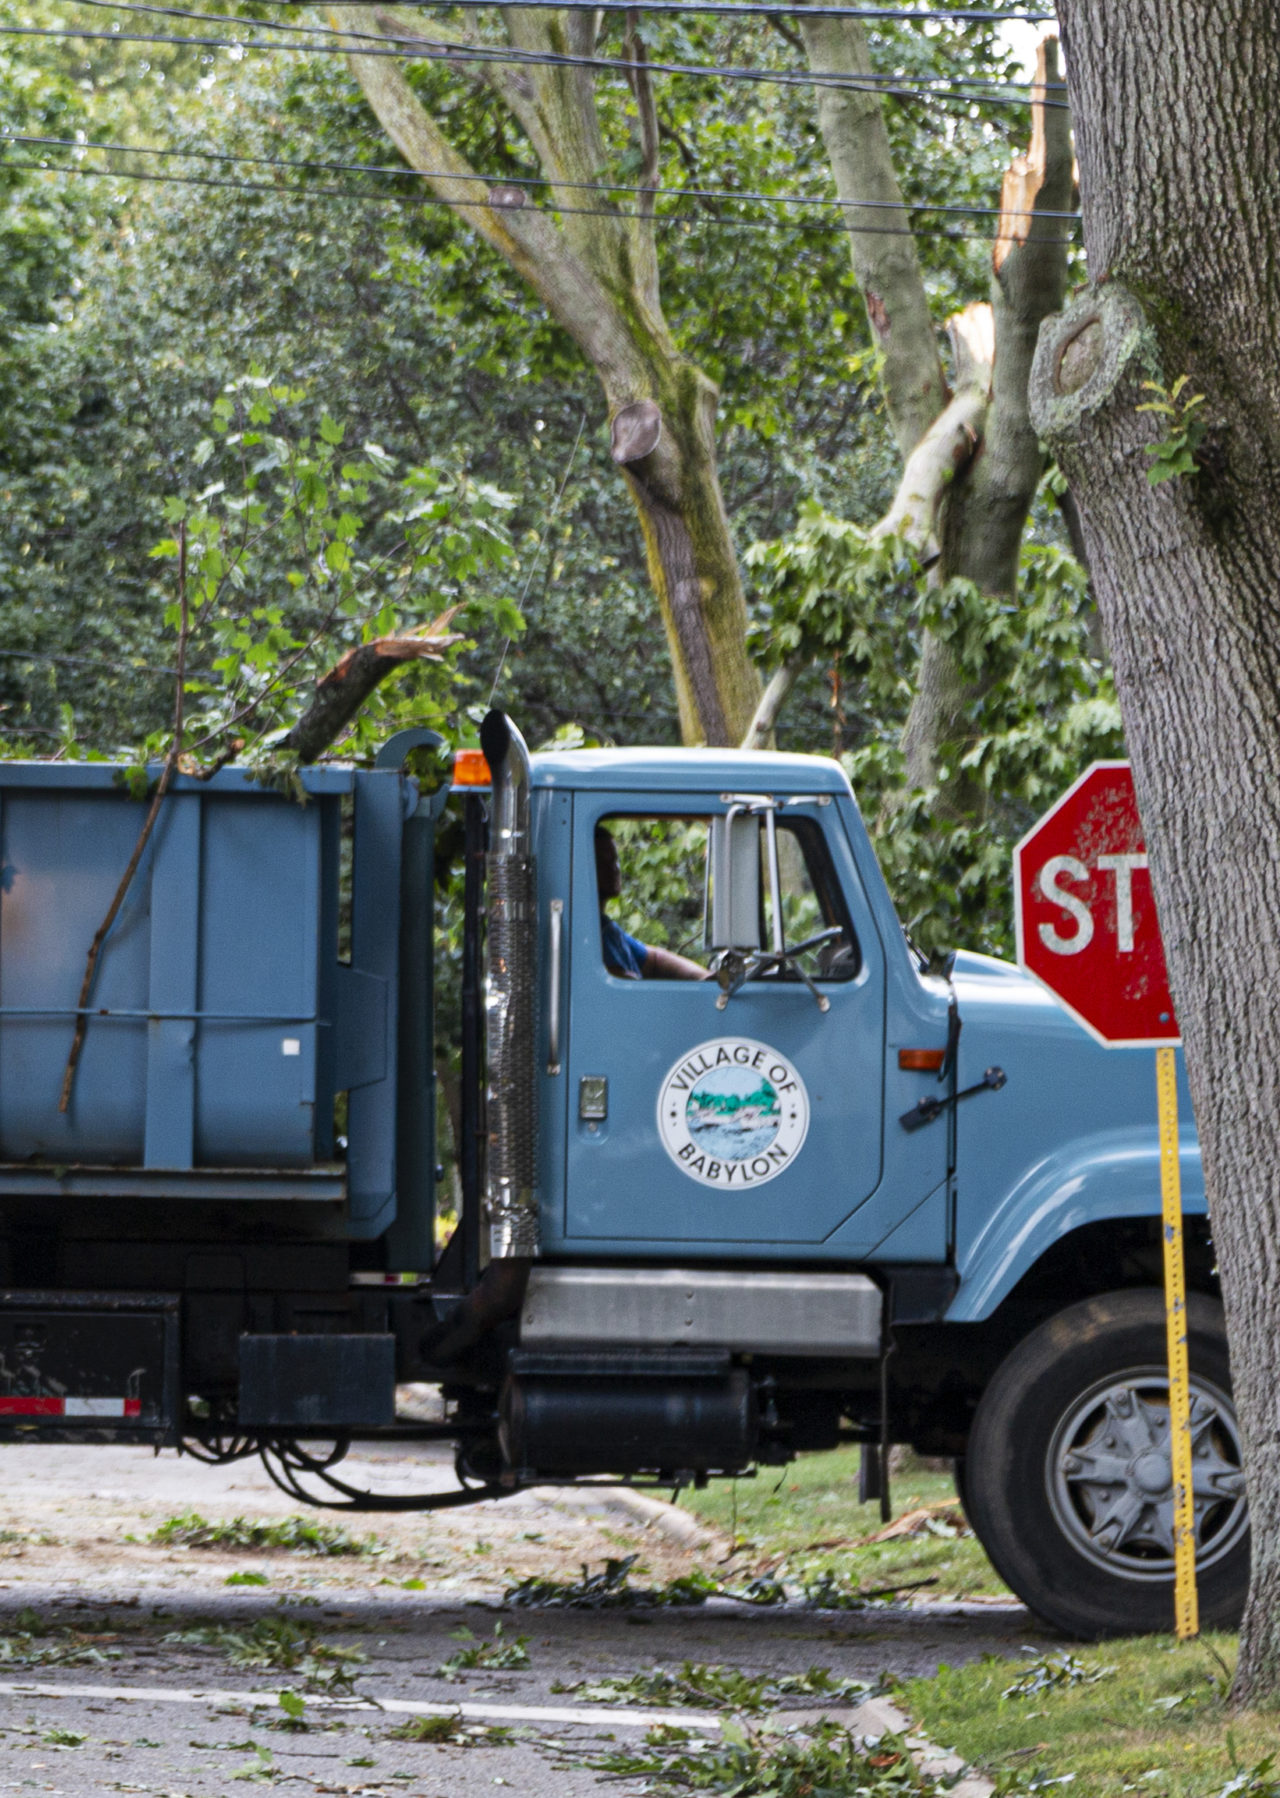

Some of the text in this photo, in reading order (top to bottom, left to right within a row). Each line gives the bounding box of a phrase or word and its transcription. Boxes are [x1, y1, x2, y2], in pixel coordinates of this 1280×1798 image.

[1038, 853, 1149, 955] ST
[671, 1046, 798, 1094] VILLAGE OF
[678, 1143, 789, 1182] BABYLON
